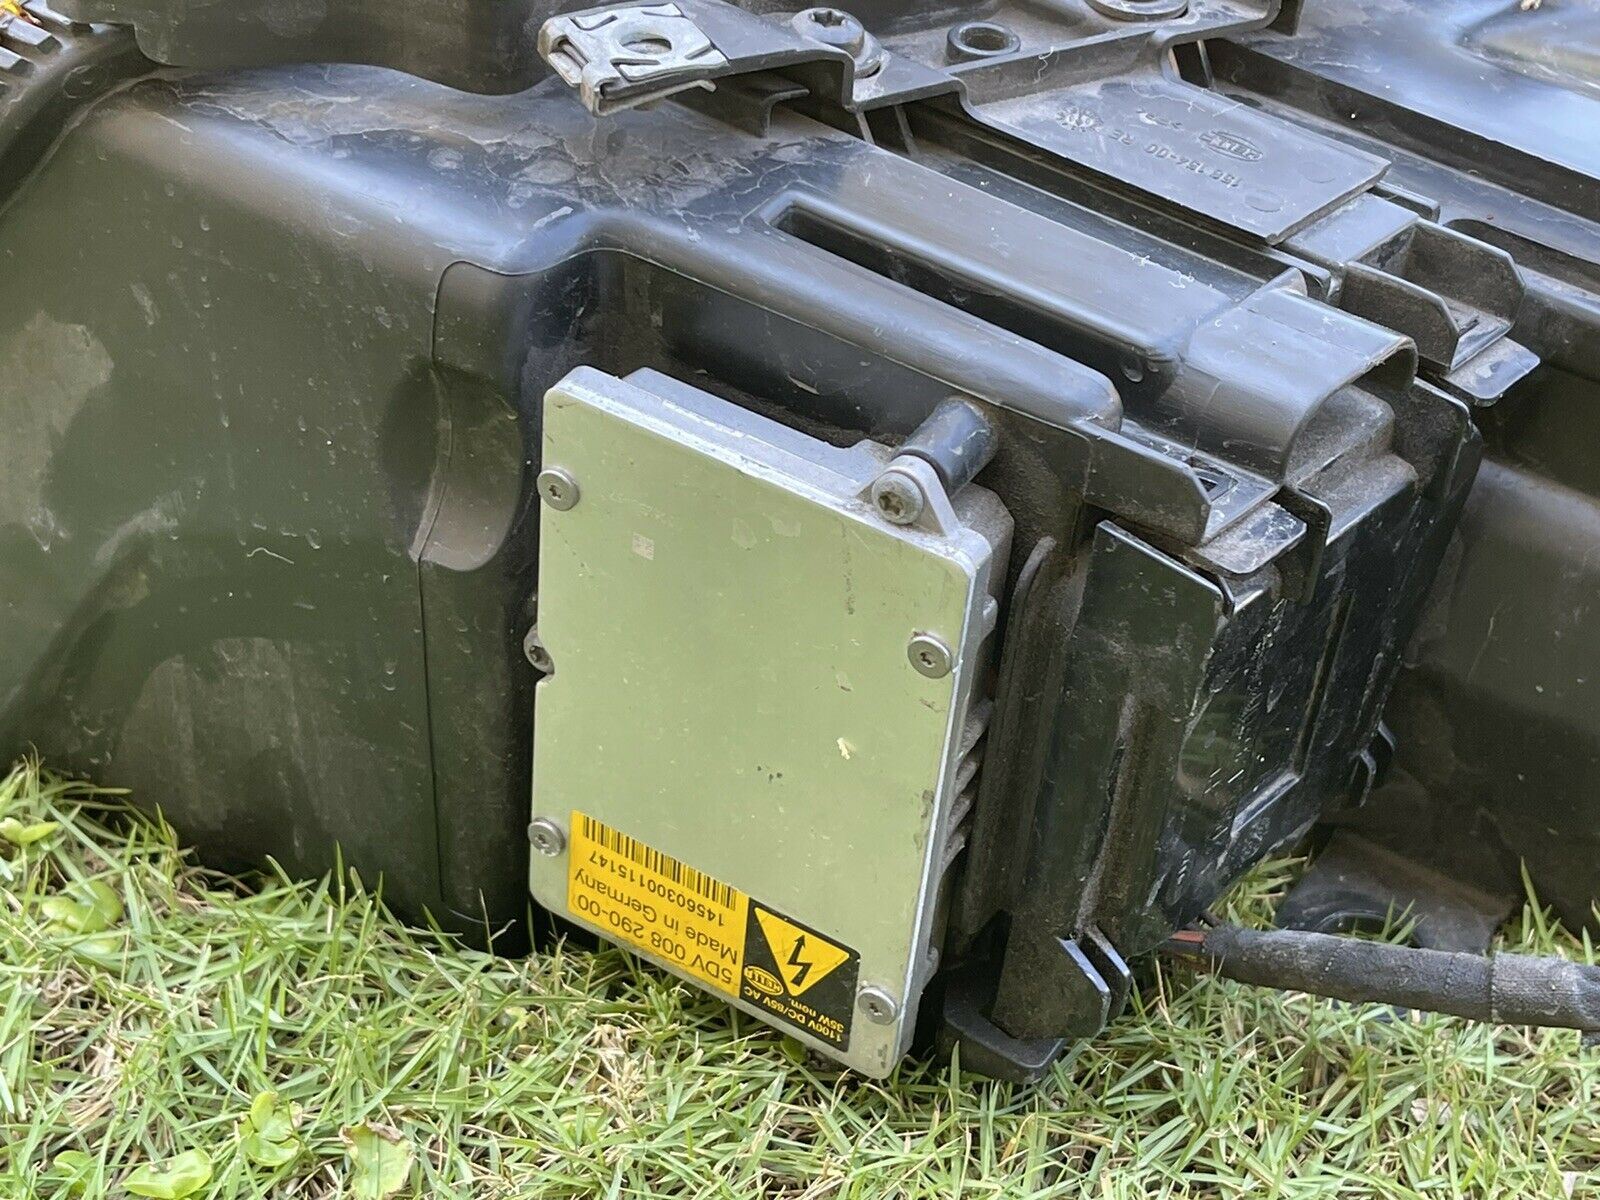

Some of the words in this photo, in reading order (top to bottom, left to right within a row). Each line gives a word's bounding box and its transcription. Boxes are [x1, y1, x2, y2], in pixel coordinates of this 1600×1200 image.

[574, 868, 657, 923] Germany
[589, 850, 724, 927] 14560300115147
[577, 894, 645, 940] 290-00
[664, 914, 679, 936] in
[650, 931, 686, 961] 008
[685, 926, 738, 965] Made
[691, 954, 733, 985] 5DV
[743, 986, 761, 1000] AC
[818, 1014, 845, 1033] 35W
